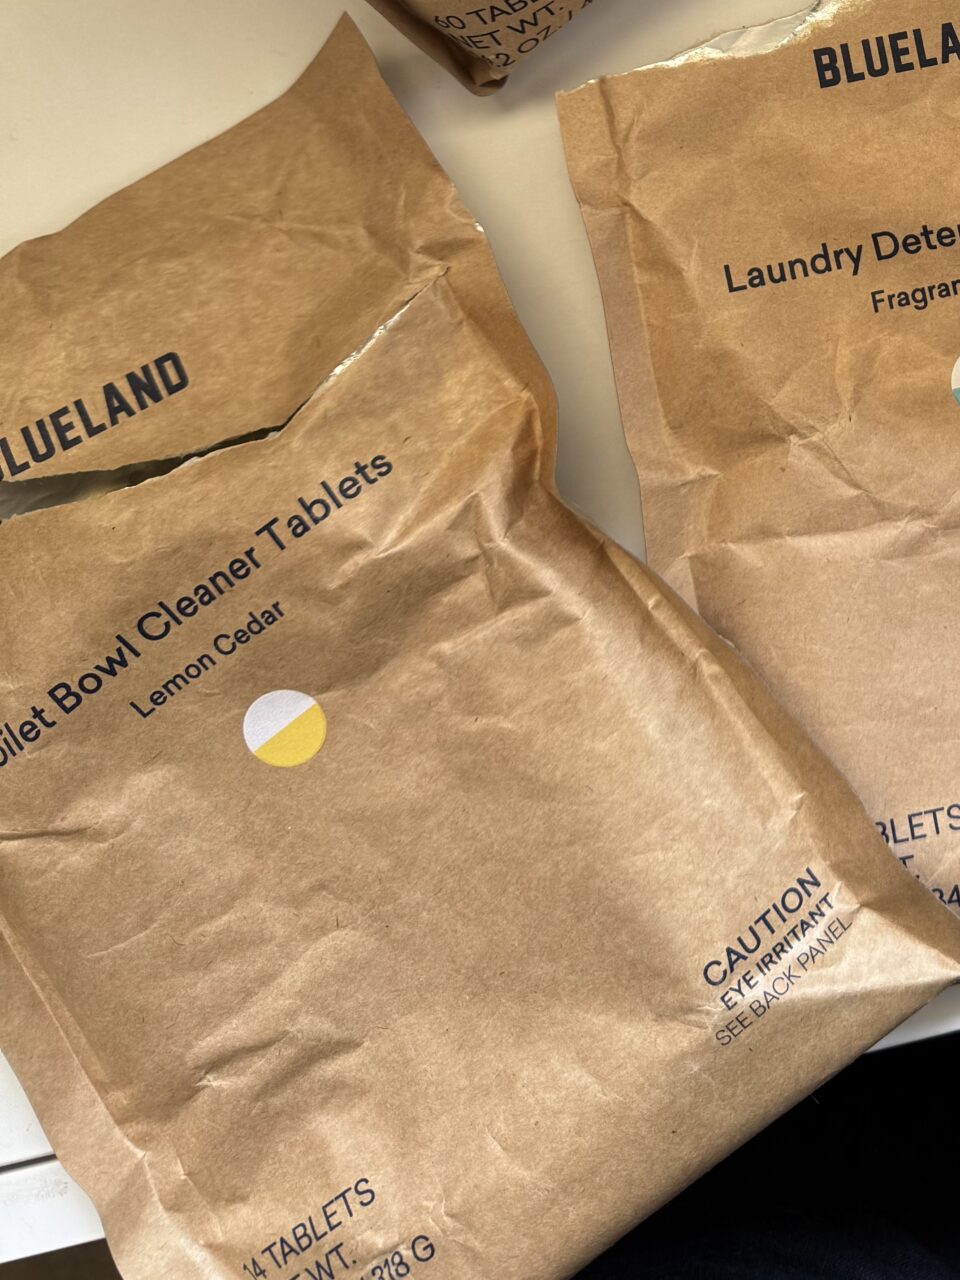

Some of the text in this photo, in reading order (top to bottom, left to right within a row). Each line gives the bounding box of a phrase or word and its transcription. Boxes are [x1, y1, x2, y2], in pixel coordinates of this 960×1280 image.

[435, 15, 466, 29] 60
[507, 1, 564, 34] WT.
[724, 243, 864, 293] Laundry
[0, 351, 190, 481] LUELAND
[47, 634, 141, 714] Bowl
[137, 547, 261, 642] Cleaner
[255, 452, 393, 551] Tablets
[130, 600, 285, 718] Lemon Cedar
[703, 867, 821, 986] CAUTION
[721, 892, 833, 1010] EYE IRRITANT
[715, 917, 852, 1046] SEE BACK PANEL
[261, 1178, 375, 1269] TABLETS
[304, 1242, 357, 1280] WT.
[411, 1235, 435, 1262] G
